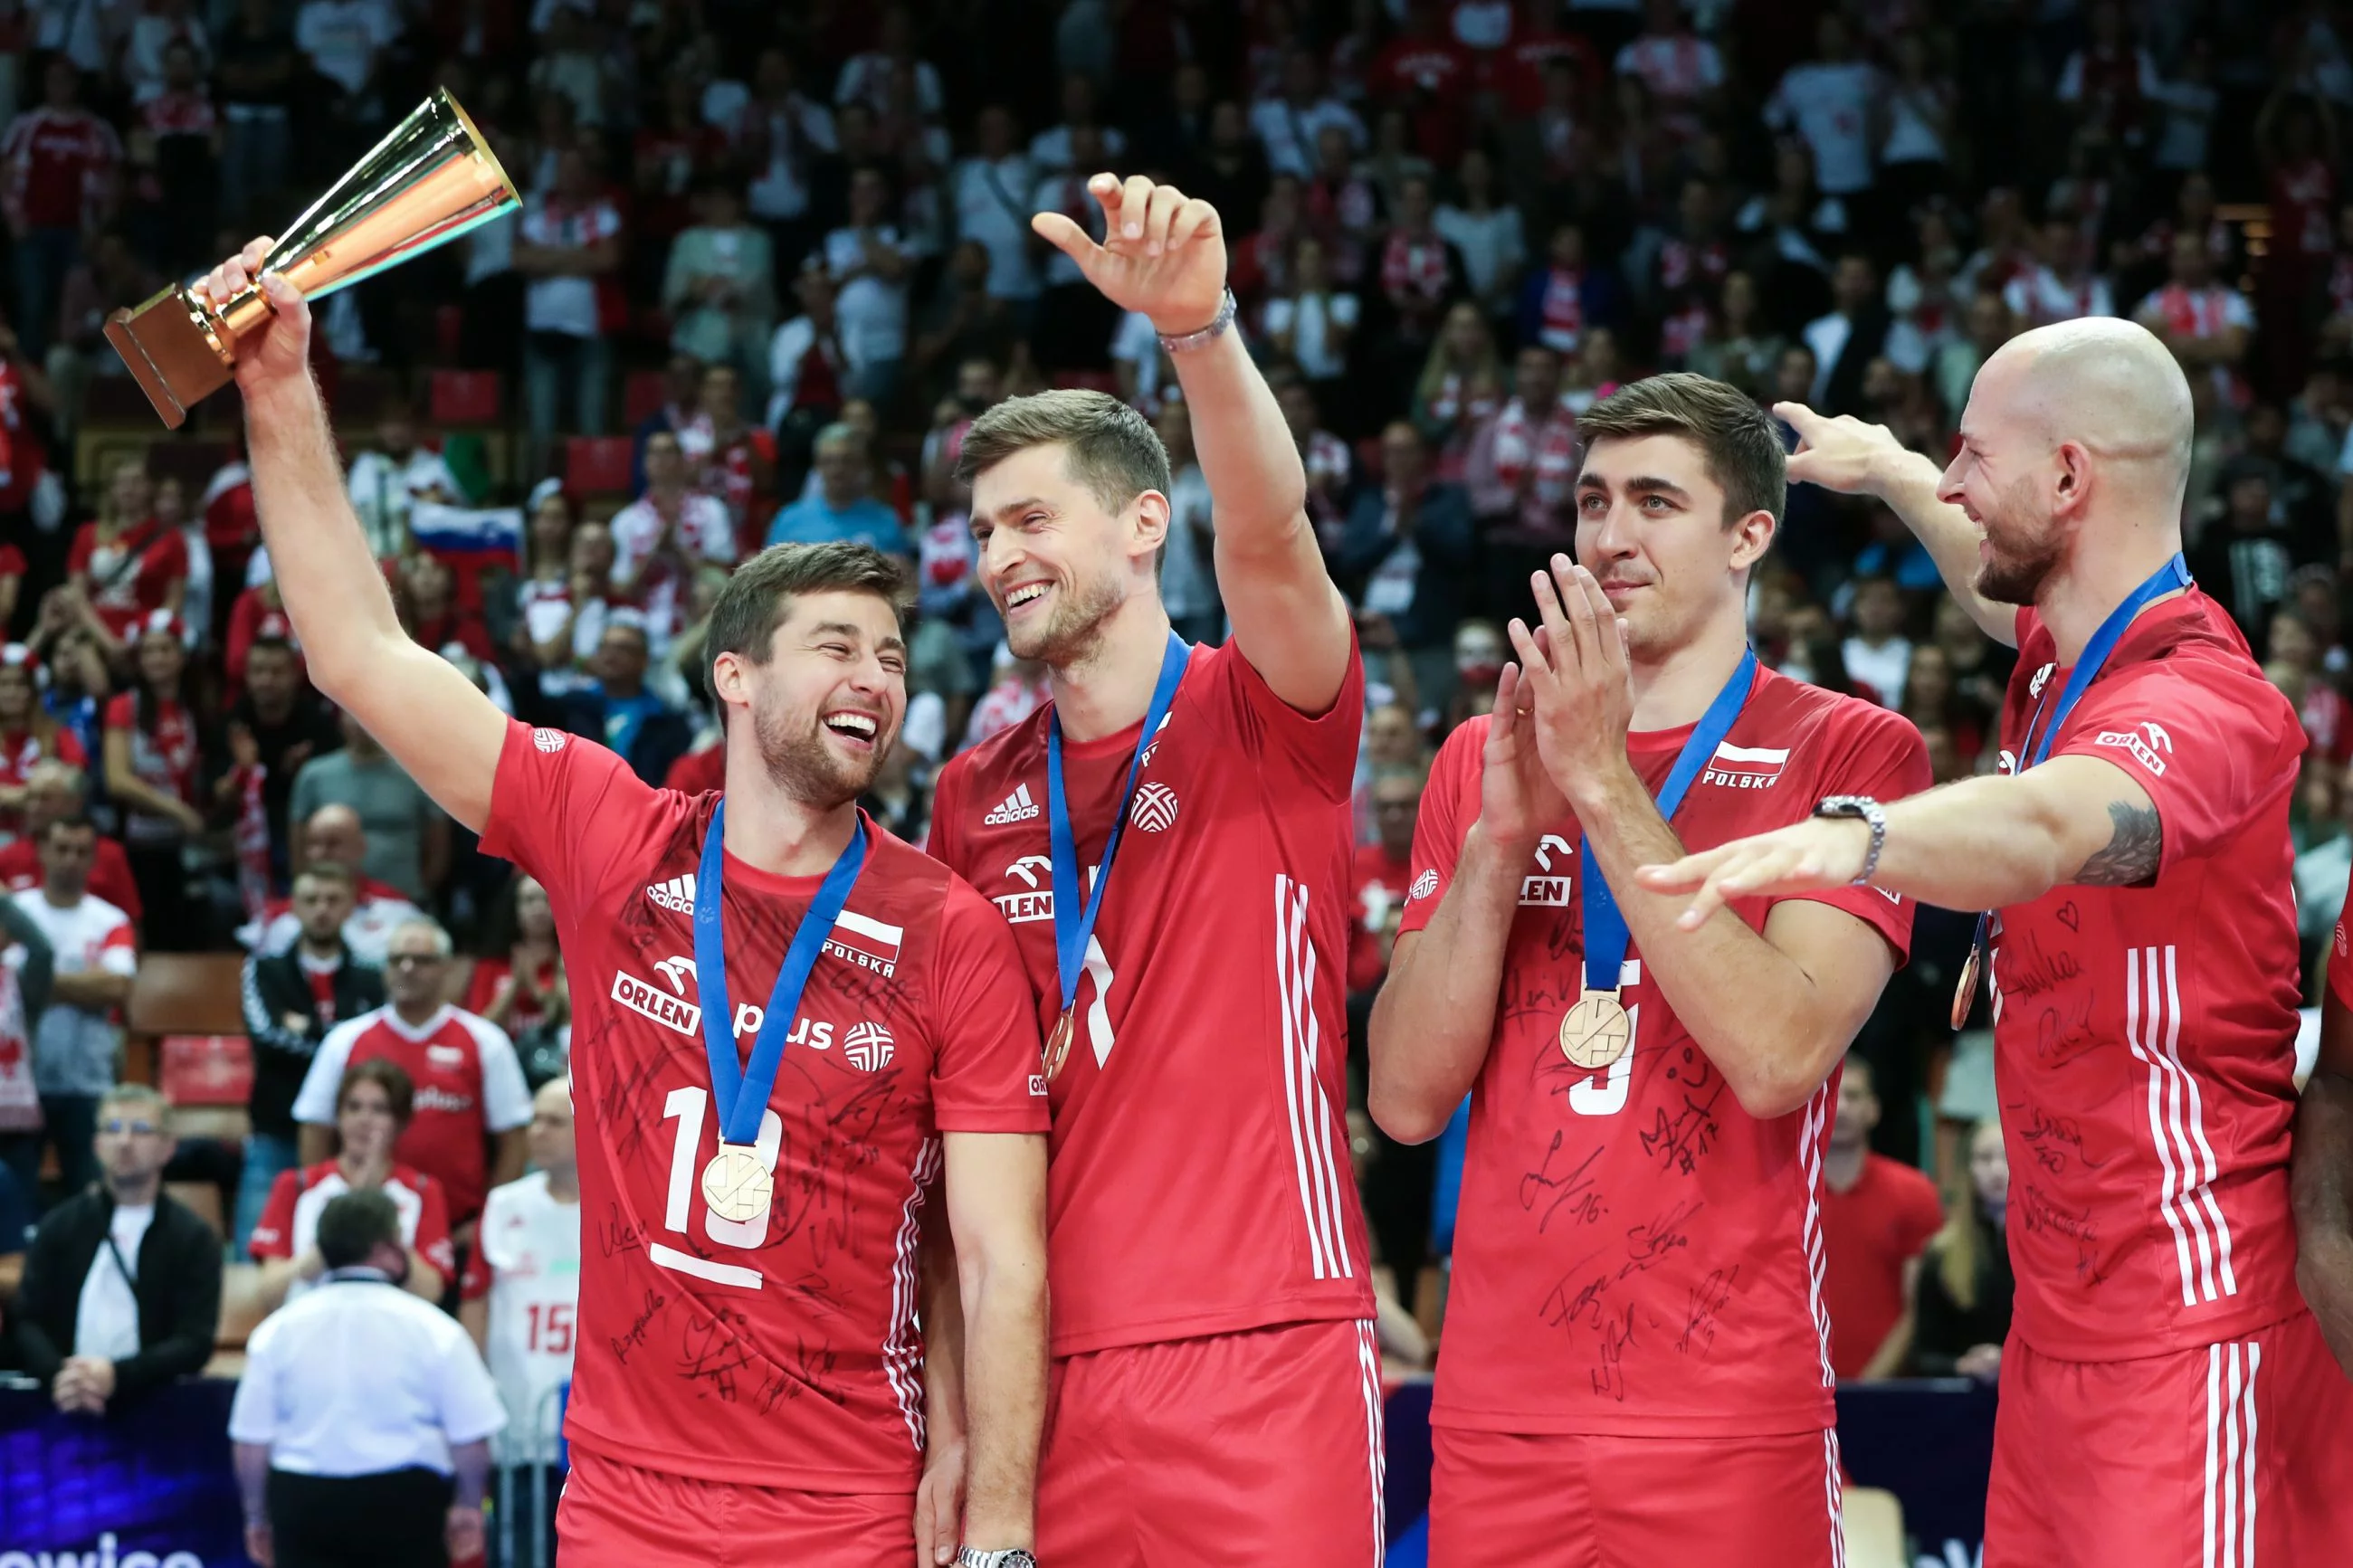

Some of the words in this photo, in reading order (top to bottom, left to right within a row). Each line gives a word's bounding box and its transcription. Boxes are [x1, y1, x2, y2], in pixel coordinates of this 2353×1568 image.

[2101, 734, 2160, 773] ORLEN
[1702, 771, 1778, 789] POLSKA
[984, 803, 1040, 826] adidas
[645, 885, 694, 917] adida
[998, 894, 1052, 919] LEN
[821, 940, 896, 979] POLSKA
[618, 979, 694, 1030] ORLEN
[732, 1002, 834, 1050] pus
[527, 1304, 573, 1356] 15
